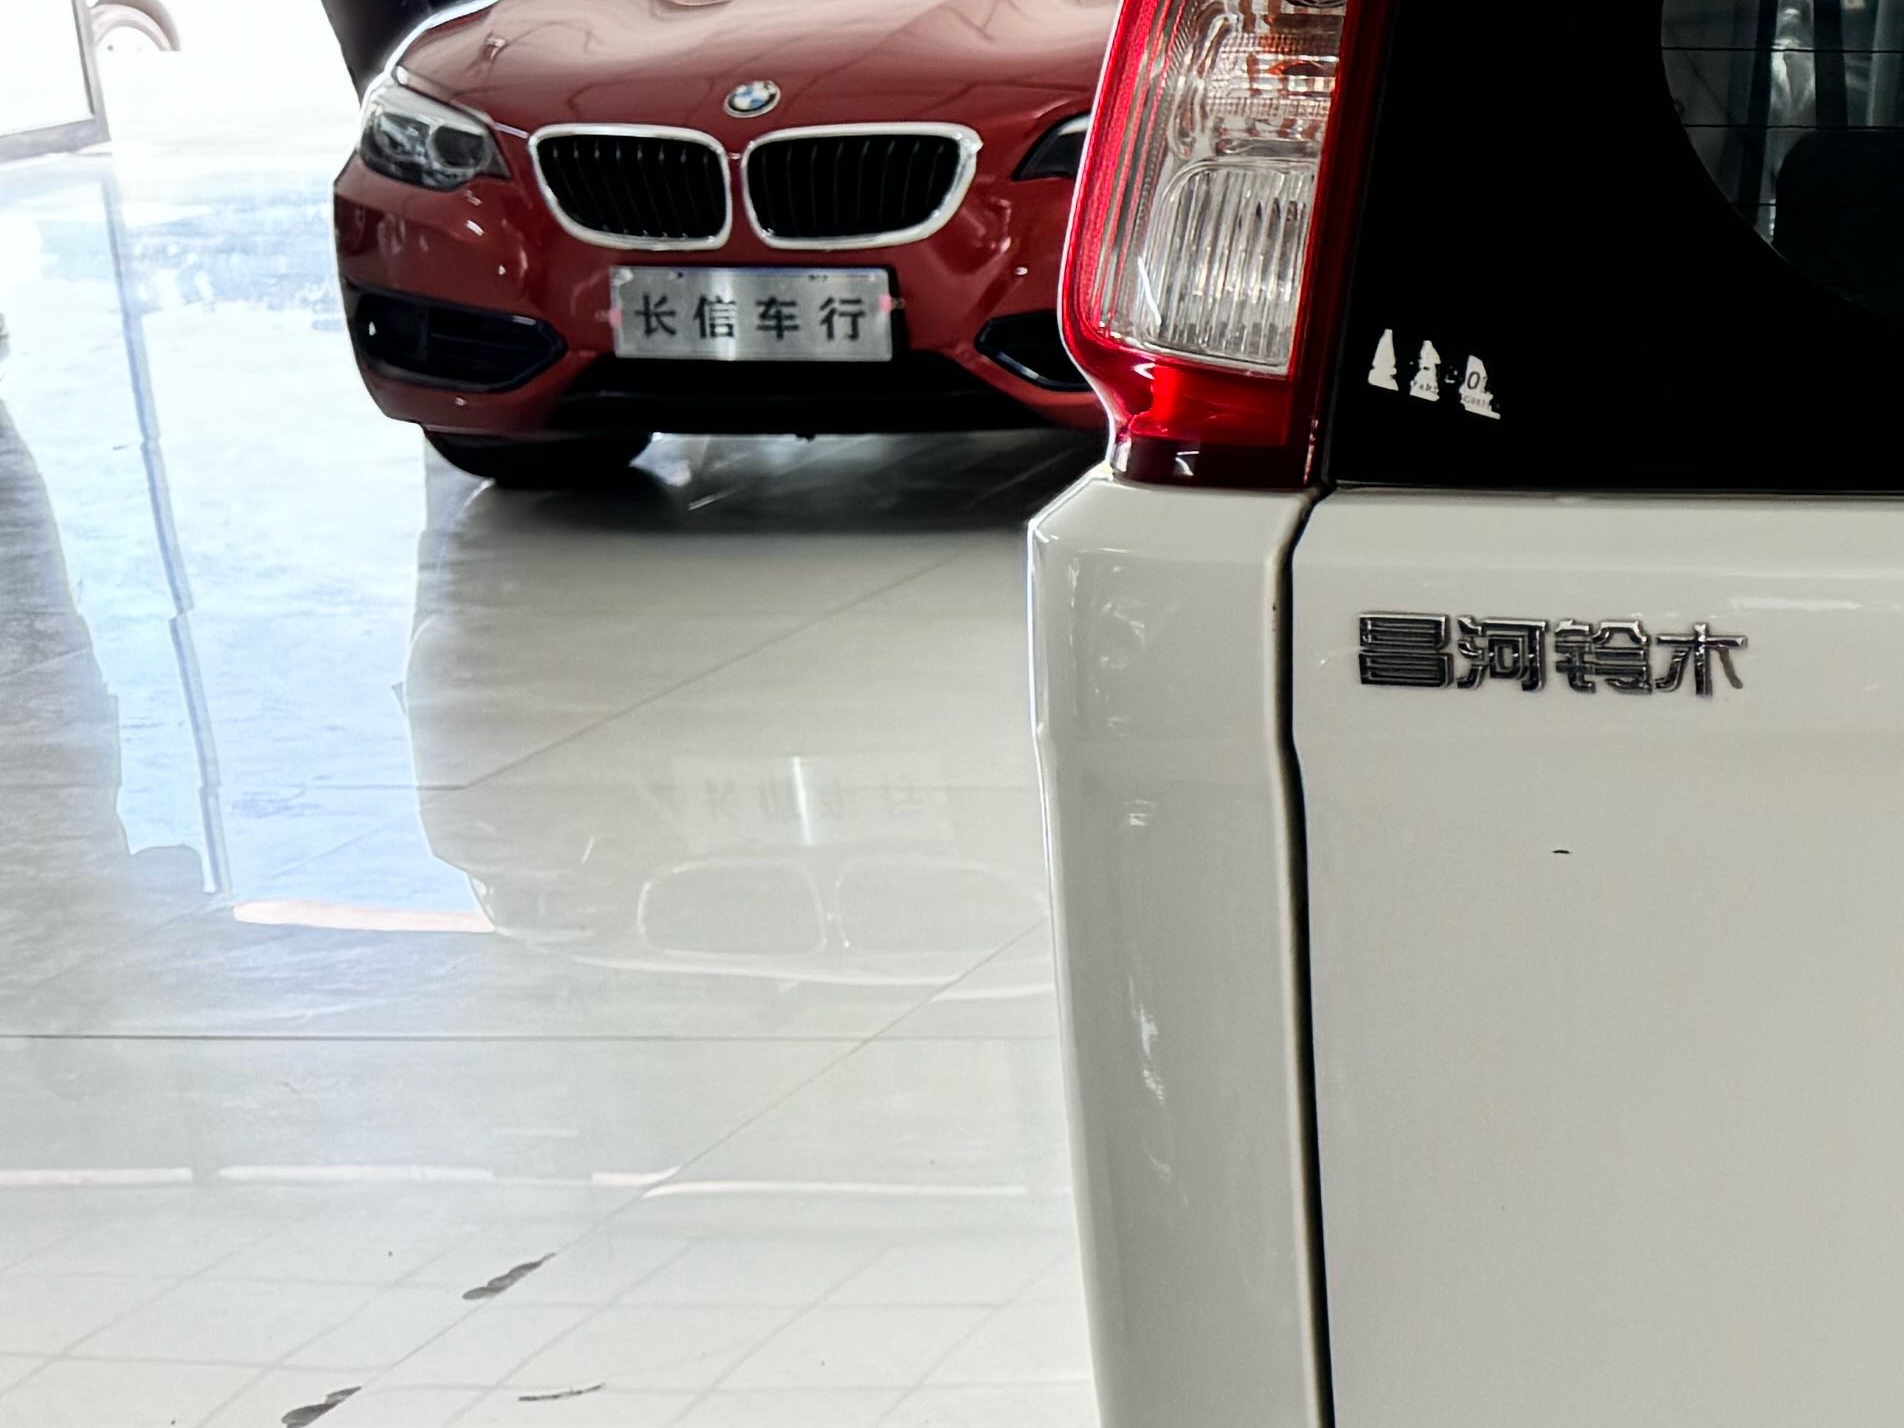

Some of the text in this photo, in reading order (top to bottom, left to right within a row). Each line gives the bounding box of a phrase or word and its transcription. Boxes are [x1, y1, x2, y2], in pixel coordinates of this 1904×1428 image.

[634, 293, 866, 342] 长信车行
[1357, 609, 1750, 698] 昌河铃木
